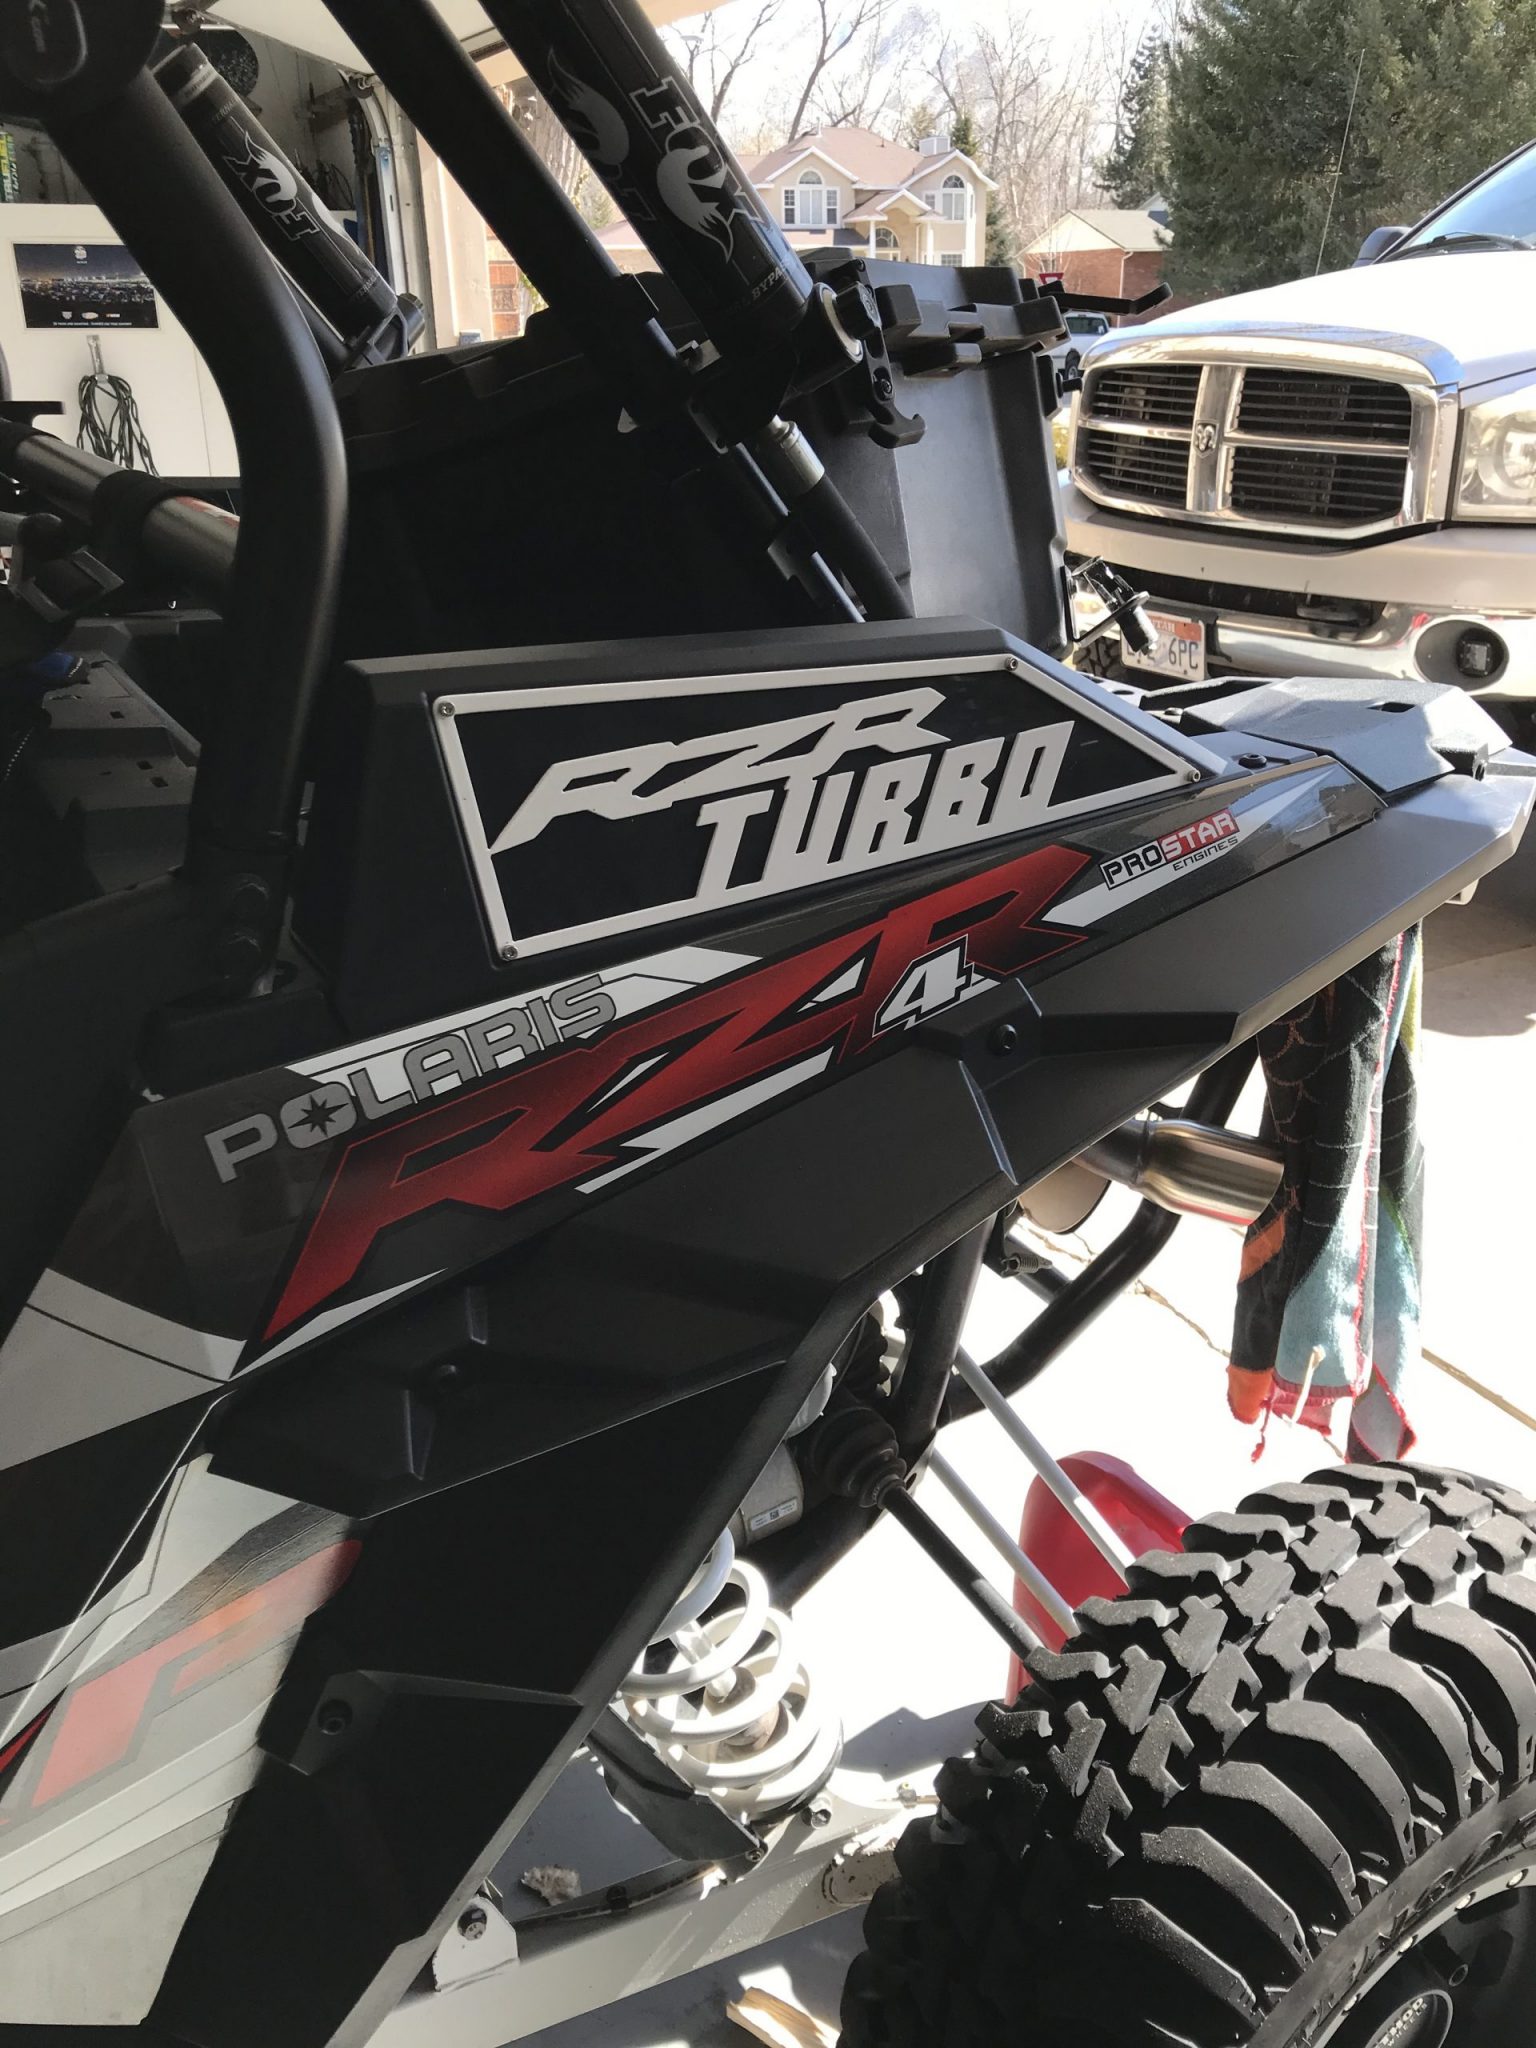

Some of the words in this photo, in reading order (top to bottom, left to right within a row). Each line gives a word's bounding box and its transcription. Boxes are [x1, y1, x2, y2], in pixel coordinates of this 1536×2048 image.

[222, 154, 320, 241] FOX
[629, 76, 768, 226] FOX
[752, 266, 787, 299] BYPA
[1152, 618, 1176, 633] TAH
[489, 687, 951, 855] RZR
[696, 720, 1076, 899] TURBO
[1102, 811, 1236, 885] PROSTAR
[1172, 835, 1239, 872] ENGINES
[872, 933, 975, 1037] 4
[203, 973, 617, 1184] POLARIS
[261, 844, 1093, 1343] RZR
